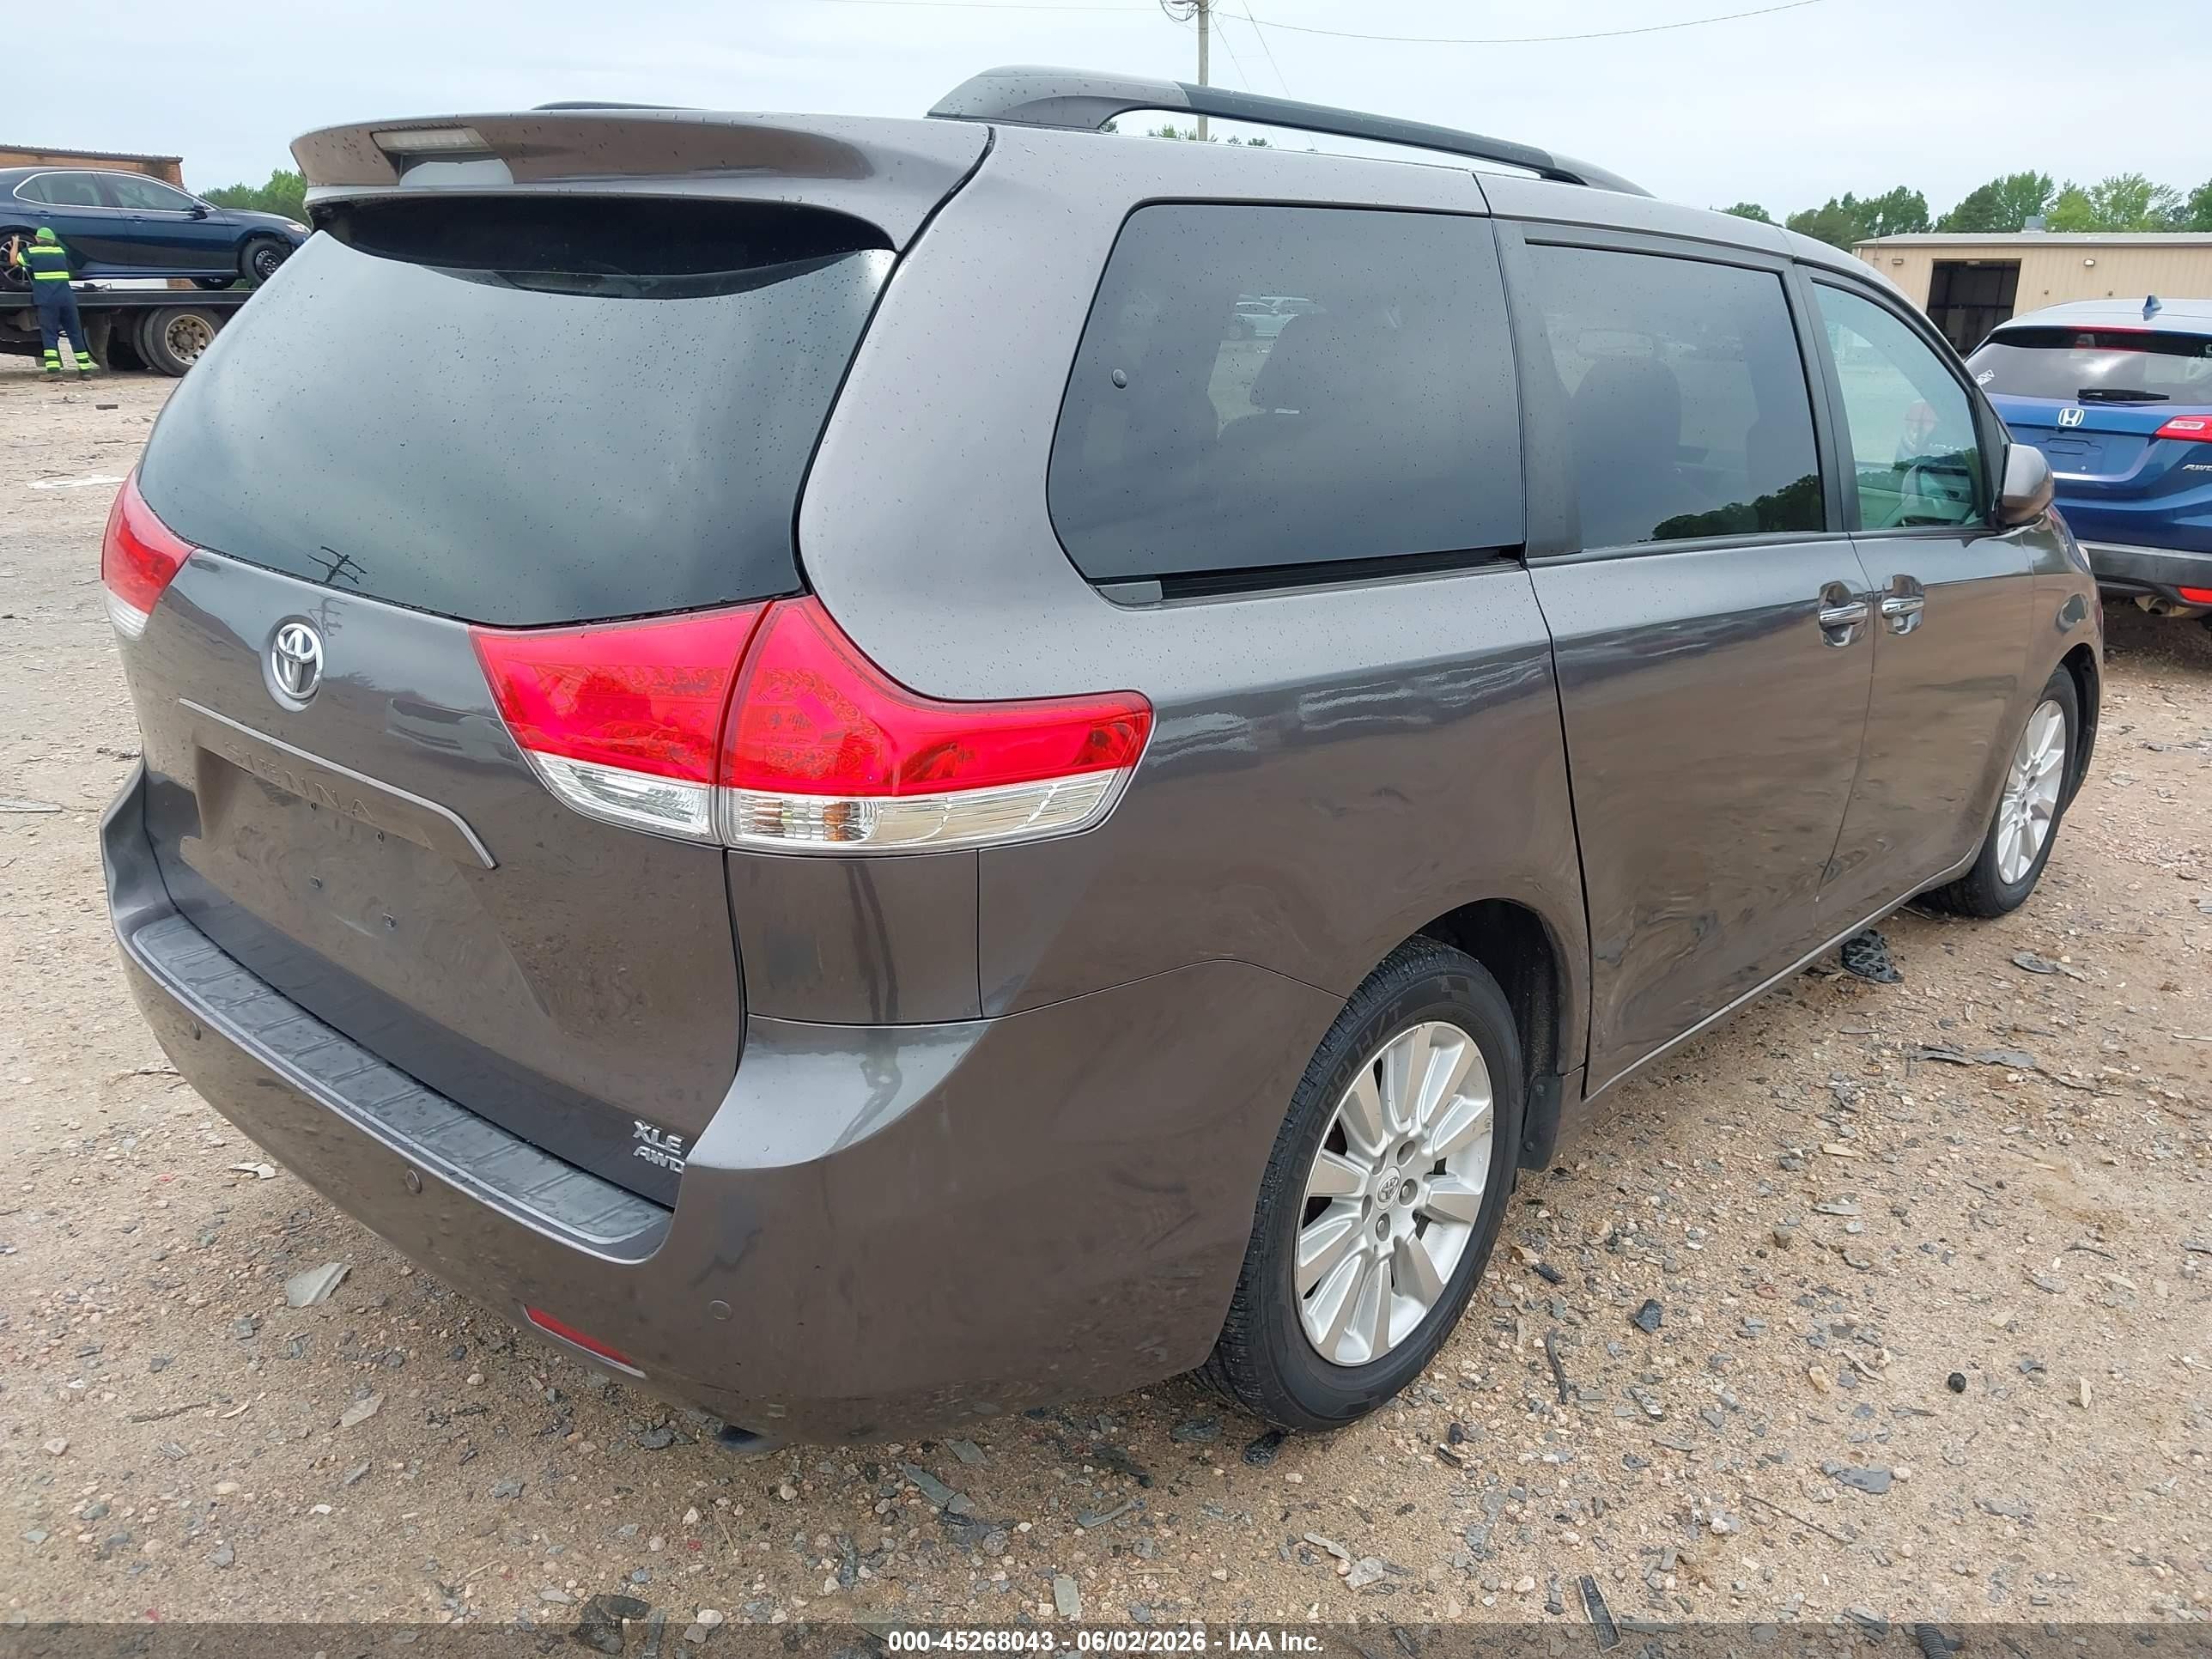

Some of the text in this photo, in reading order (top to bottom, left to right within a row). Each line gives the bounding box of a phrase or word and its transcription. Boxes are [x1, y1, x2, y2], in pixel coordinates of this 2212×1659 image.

[224, 740, 376, 823] SIENNA
[632, 1119, 684, 1156] XLE
[633, 1146, 685, 1174] AWD
